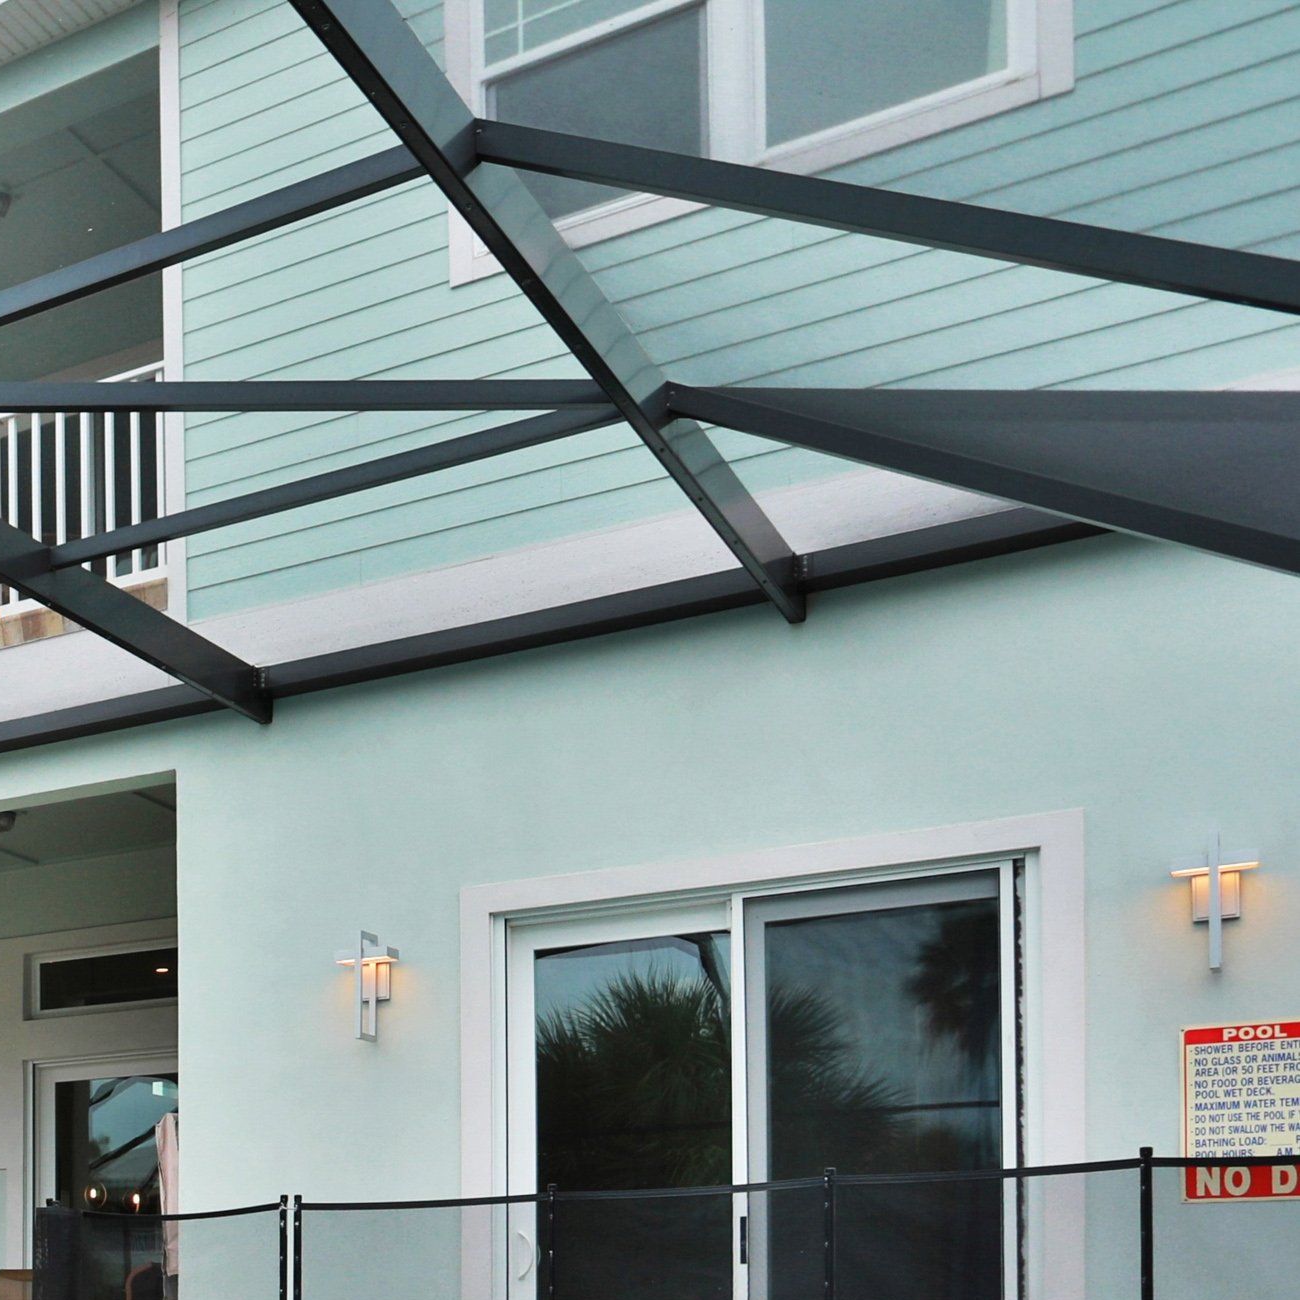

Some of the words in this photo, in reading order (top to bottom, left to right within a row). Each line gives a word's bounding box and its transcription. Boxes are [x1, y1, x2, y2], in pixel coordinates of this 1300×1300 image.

[1222, 1024, 1288, 1041] POOL
[1194, 1044, 1233, 1055] SHOWER
[1238, 1041, 1275, 1053] BEFORE
[1280, 1040, 1300, 1050] ENT
[1194, 1058, 1208, 1067] NO
[1211, 1056, 1241, 1066] GLASS
[1244, 1054, 1258, 1064] OR
[1195, 1068, 1219, 1077] AREA
[1222, 1066, 1238, 1077] (OR
[1241, 1065, 1253, 1075] 50
[1257, 1063, 1280, 1073] FEET
[1194, 1080, 1208, 1089] NO
[1211, 1078, 1237, 1088] FOOD
[1240, 1077, 1254, 1087] OR
[1195, 1090, 1220, 1100] POOL
[1223, 1088, 1243, 1098] WET
[1246, 1087, 1275, 1097] DECK.
[1194, 1100, 1240, 1111] MAXIMUM
[1243, 1098, 1276, 1109] WATER
[1195, 1115, 1206, 1124] DO
[1208, 1113, 1225, 1123] NOT
[1228, 1112, 1243, 1122] USE
[1246, 1111, 1260, 1121] THE
[1263, 1110, 1285, 1120] POOL
[1288, 1110, 1295, 1119] IF
[1195, 1127, 1206, 1136] DO
[1208, 1125, 1225, 1135] NOT
[1228, 1123, 1267, 1135] SWALLOW
[1270, 1123, 1285, 1132] THE
[1195, 1137, 1236, 1148] BATHING
[1238, 1136, 1267, 1146] LOAD:
[1196, 1166, 1251, 1196] NO
